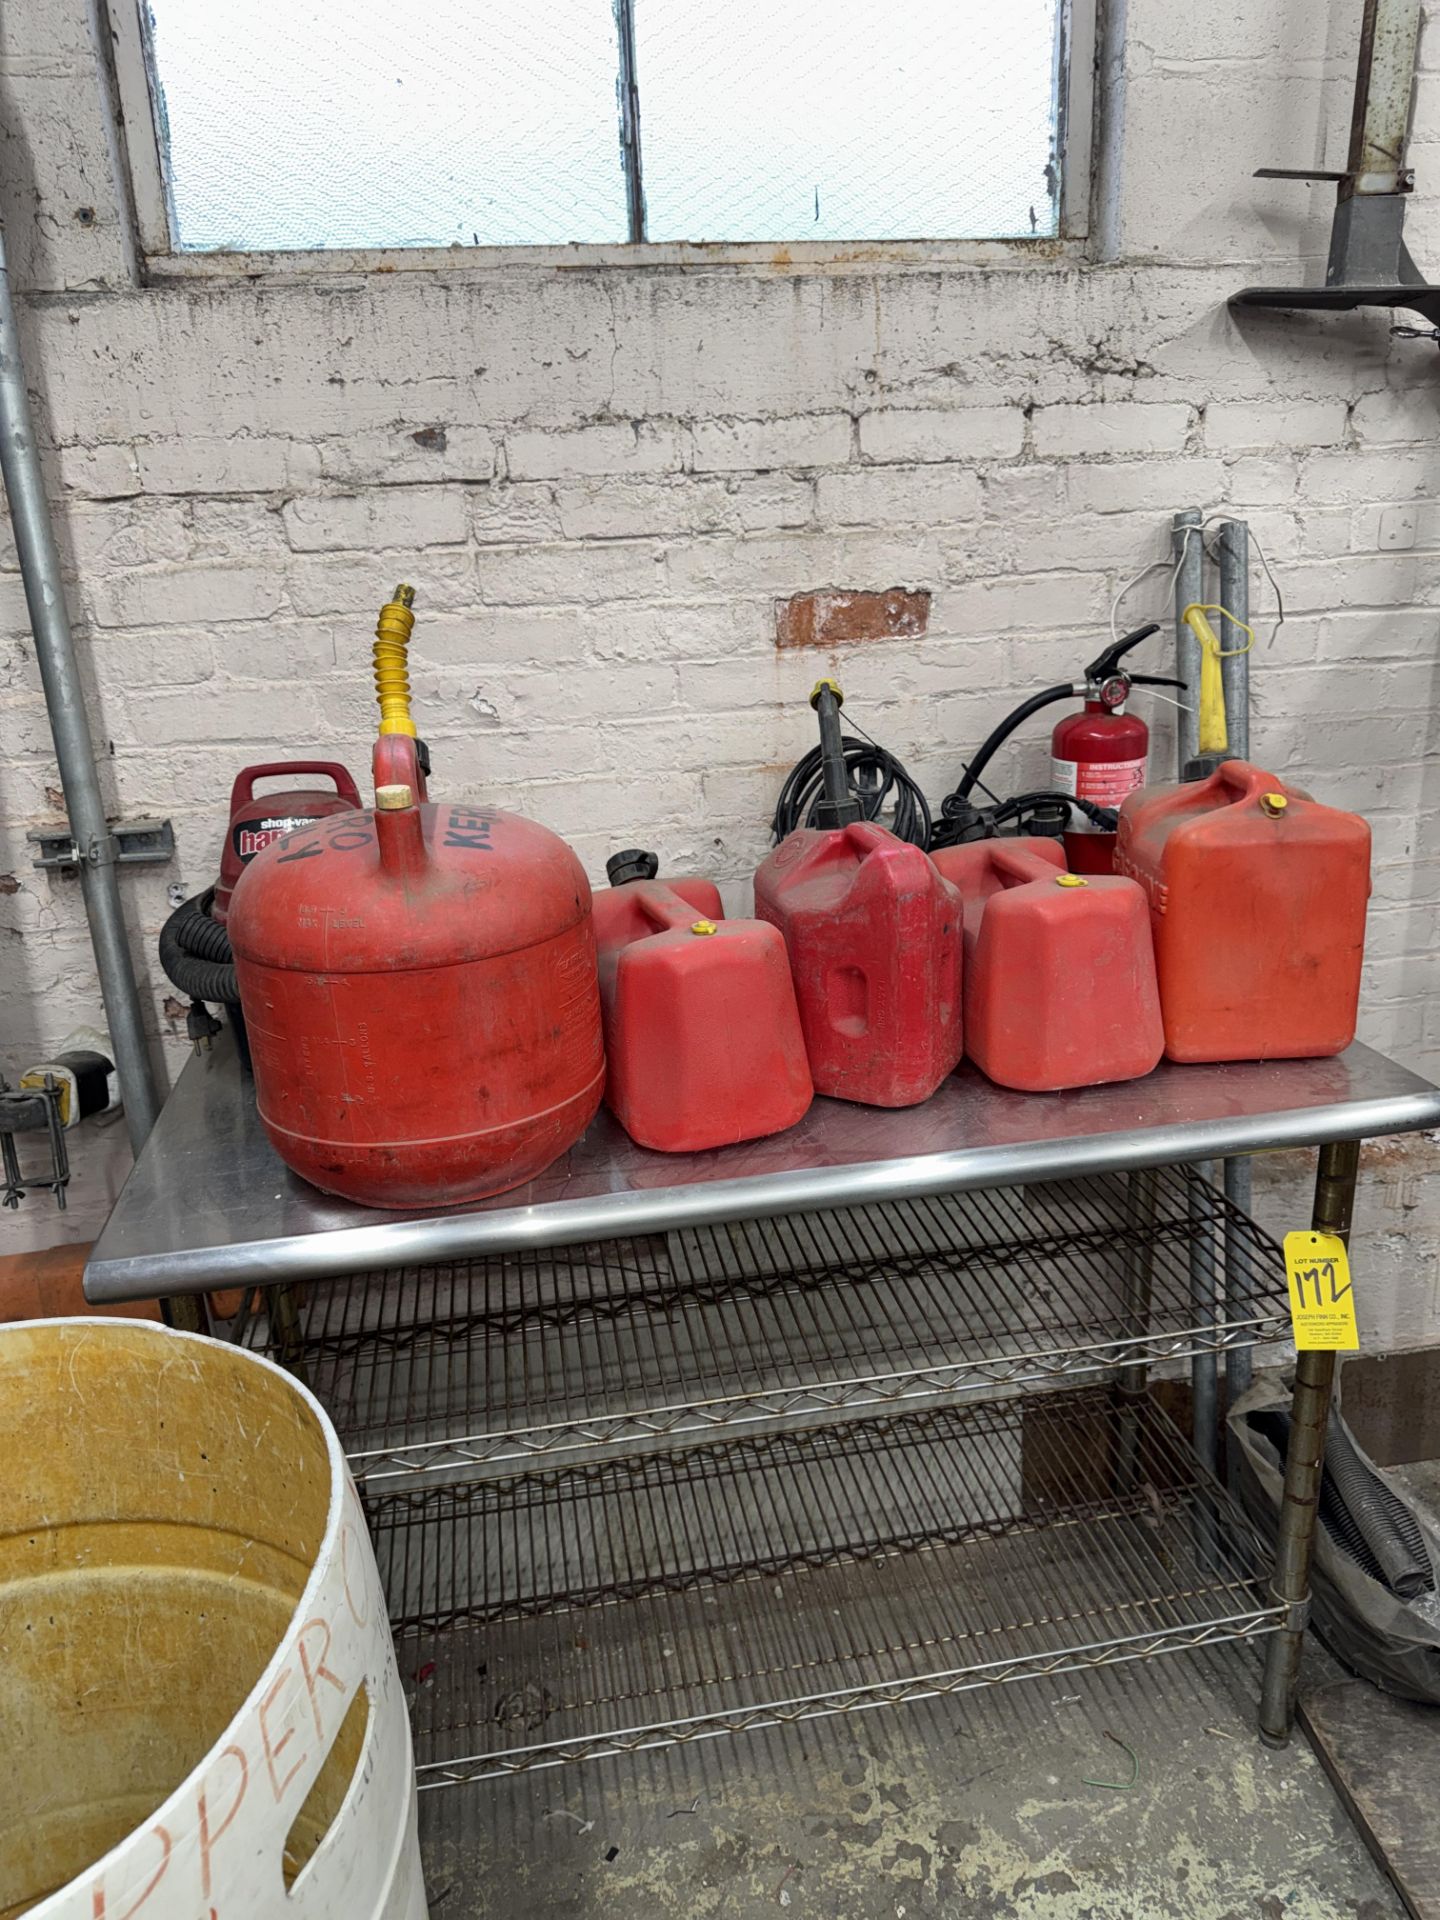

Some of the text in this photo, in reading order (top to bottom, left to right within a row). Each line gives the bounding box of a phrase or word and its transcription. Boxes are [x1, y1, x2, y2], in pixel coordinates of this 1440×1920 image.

[443, 804, 497, 852] KER
[1309, 1257, 1340, 1265] NUMBER
[1294, 1262, 1352, 1309] 172
